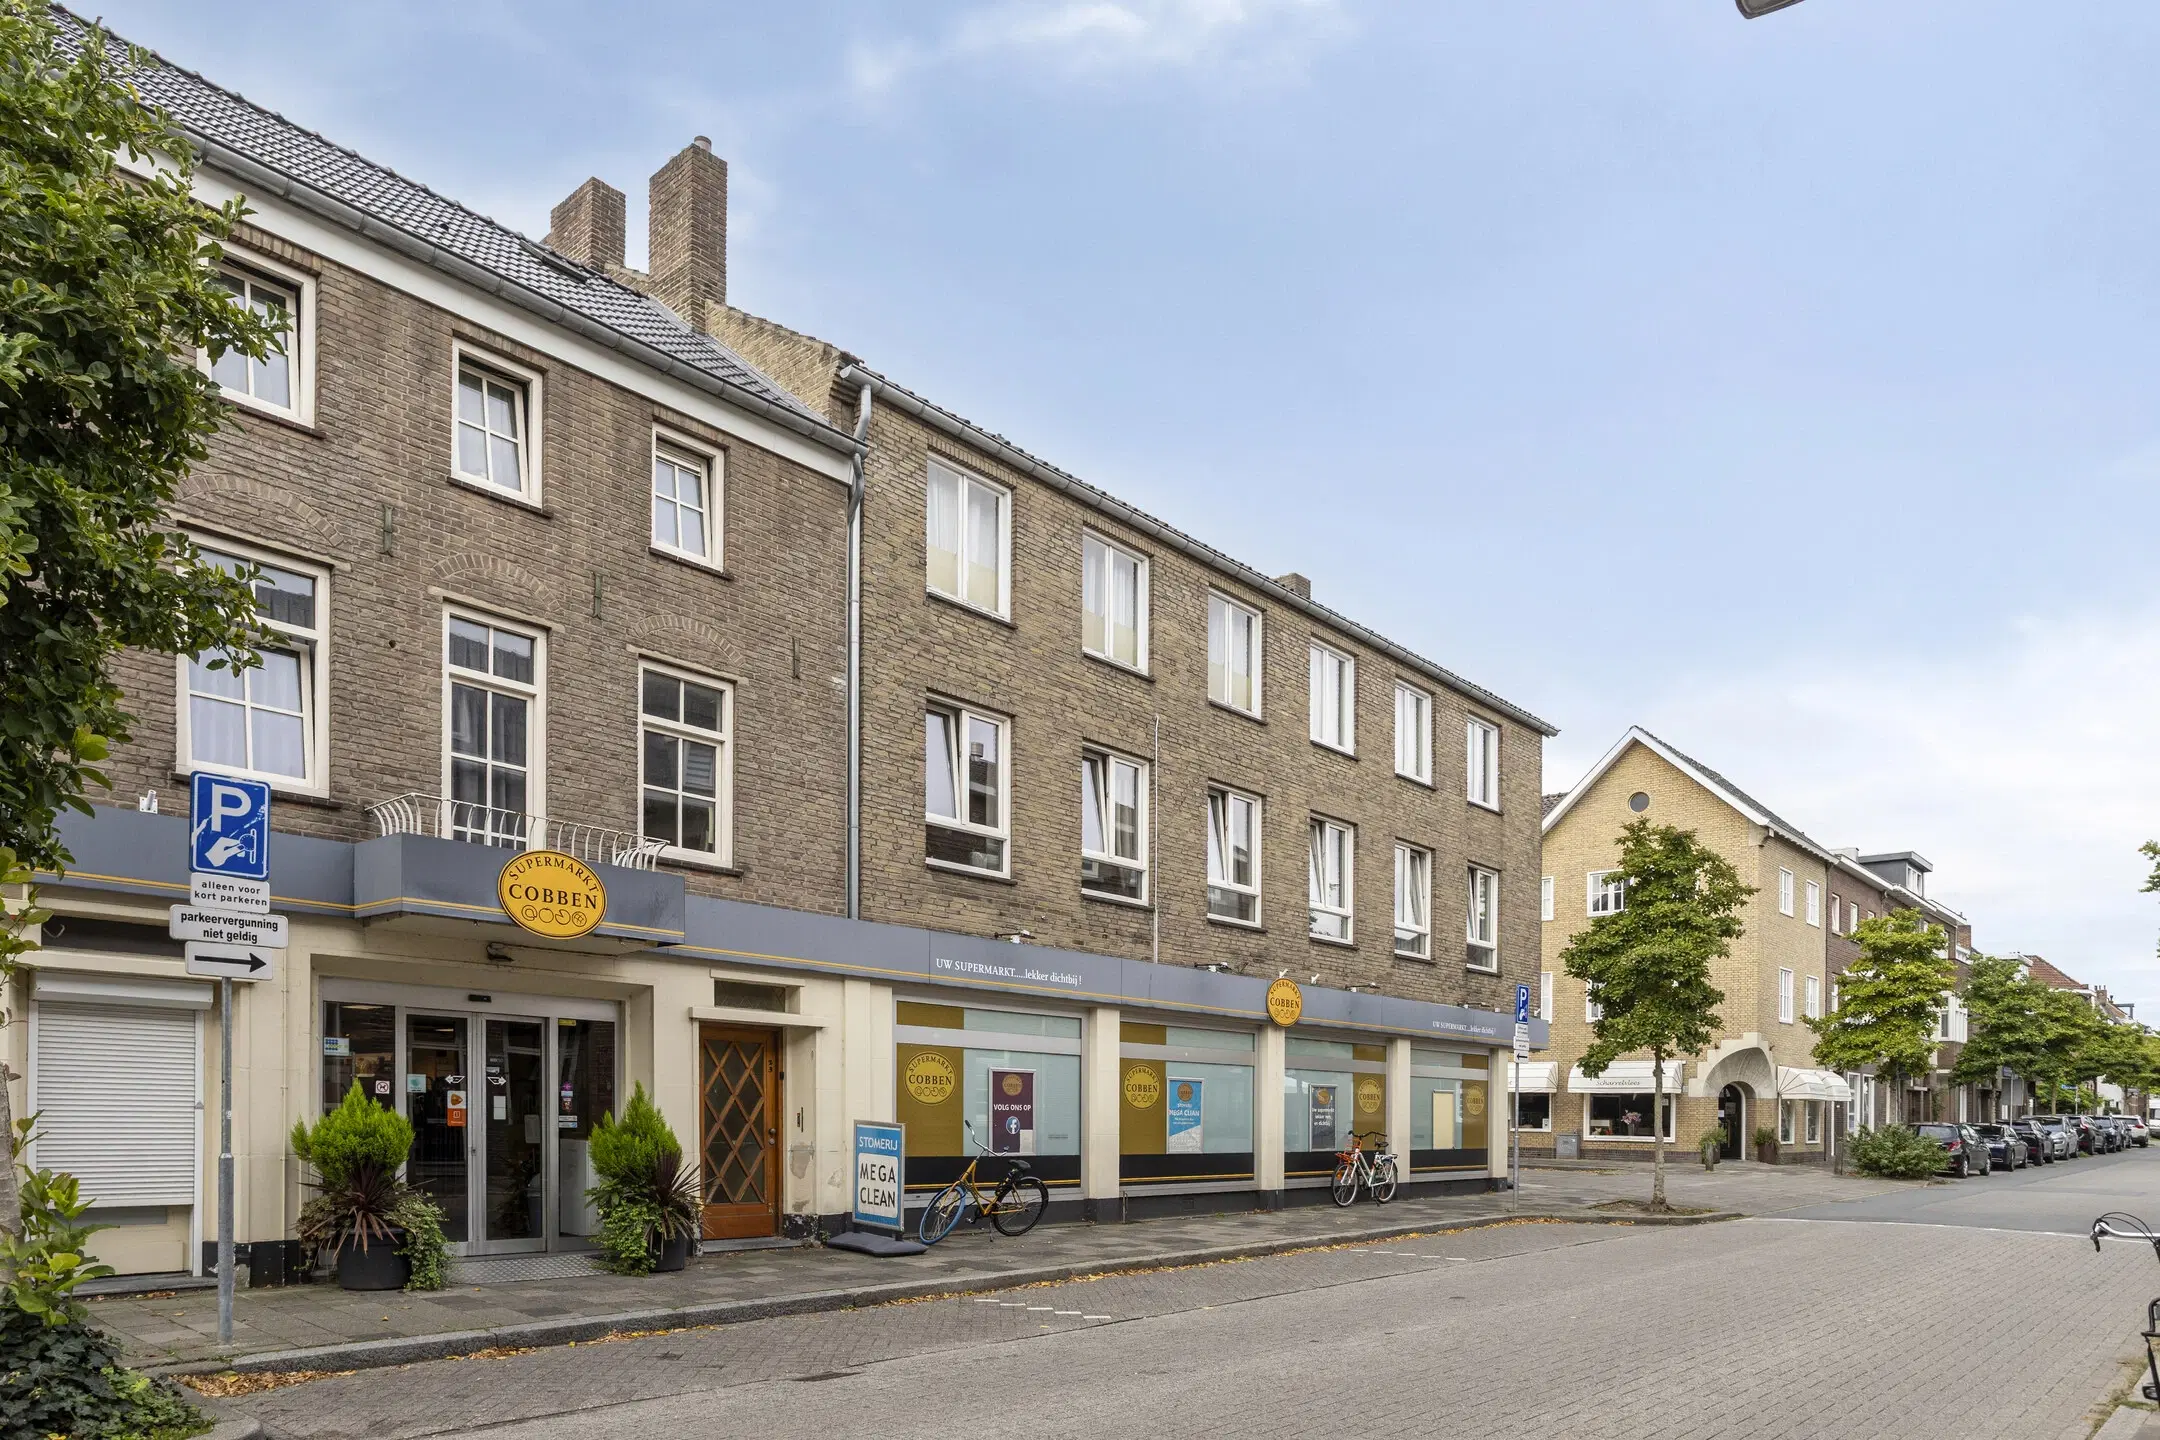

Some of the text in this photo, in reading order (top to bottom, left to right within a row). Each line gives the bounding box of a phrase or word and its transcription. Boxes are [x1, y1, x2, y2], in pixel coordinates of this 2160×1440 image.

[211, 783, 251, 832] P
[509, 856, 599, 892] SUPERMARKT
[201, 881, 261, 895] alleen voor
[508, 883, 598, 909] COBBEN
[194, 890, 267, 906] kort parkeren
[181, 912, 279, 931] parkeervergunning
[203, 928, 258, 944] niet geldig
[936, 958, 953, 969] UW
[1050, 972, 1078, 987] dichtbij
[1269, 997, 1300, 1009] COBBEN
[1520, 988, 1528, 1008] P
[909, 1056, 954, 1075] SUPERMARKT
[908, 1074, 952, 1086] COBBEN
[1126, 1083, 1158, 1093] COBBEN
[993, 1103, 1010, 1111] VOLG
[858, 1136, 898, 1151] STOMERIJ
[859, 1162, 897, 1184] MEGA
[860, 1186, 896, 1208] CLEAN
